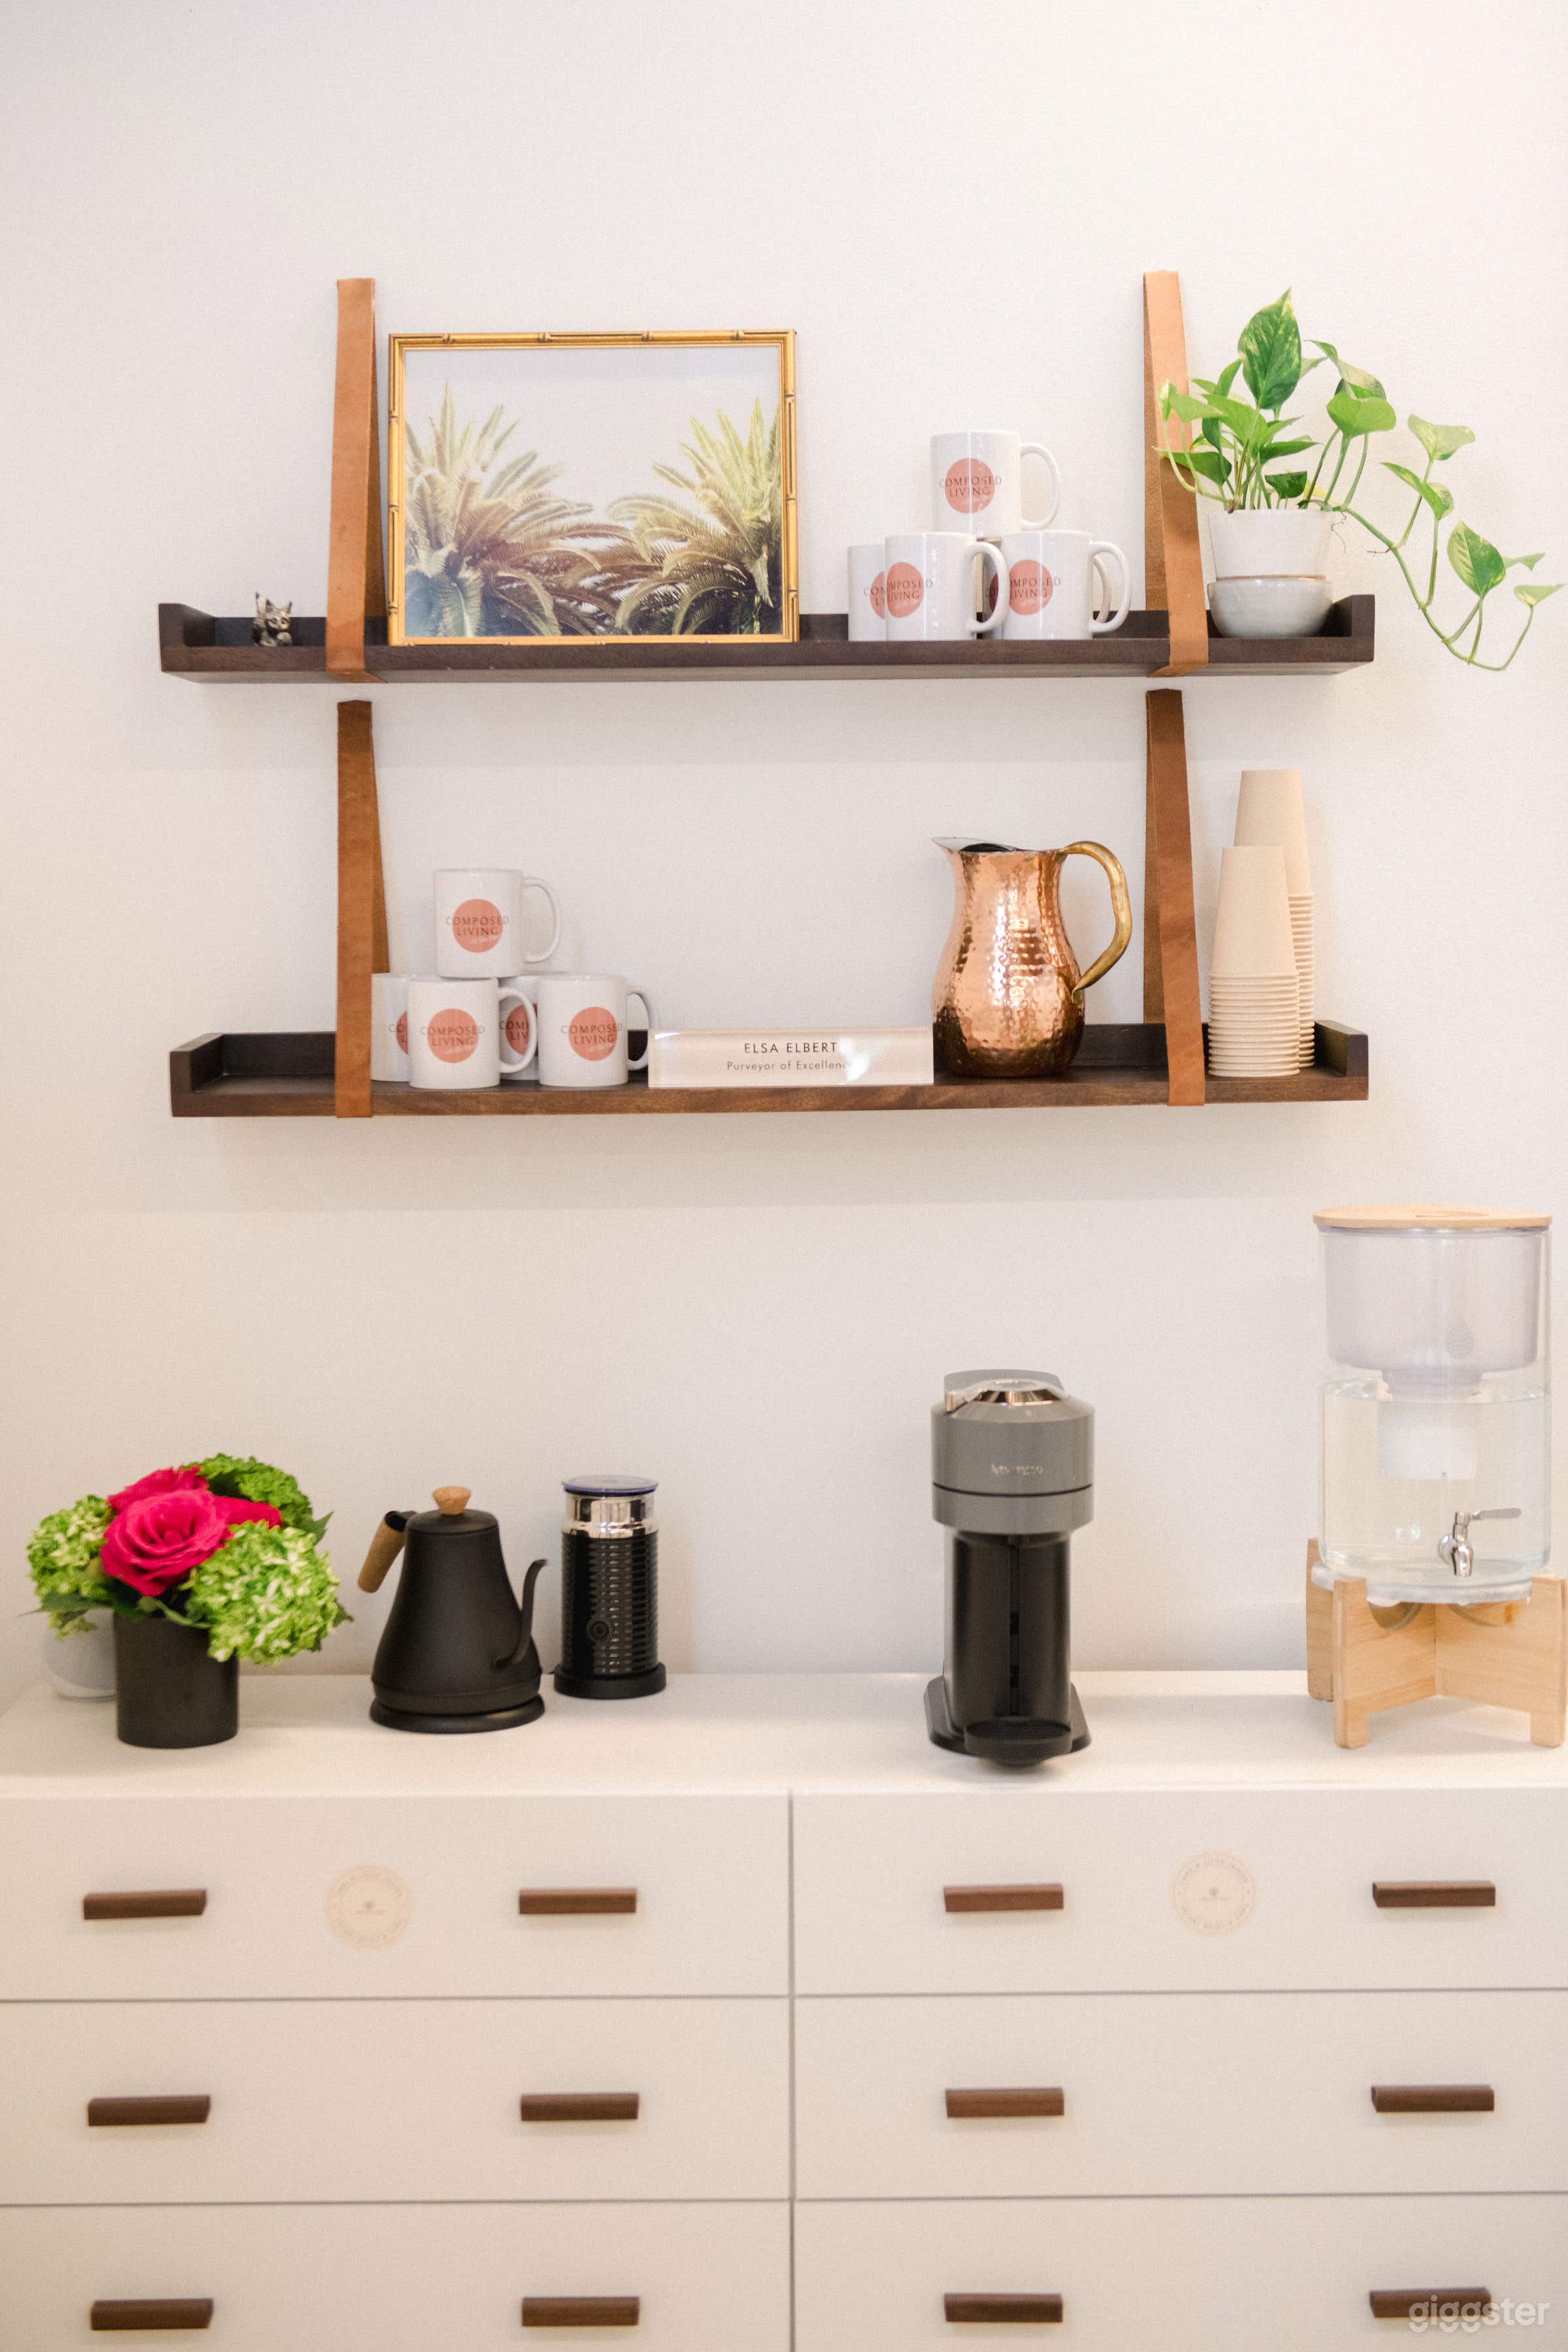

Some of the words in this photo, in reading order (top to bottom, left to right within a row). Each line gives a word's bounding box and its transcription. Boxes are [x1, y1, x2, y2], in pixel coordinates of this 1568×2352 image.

[939, 476, 1002, 488] COMPOSED
[949, 487, 990, 497] LIVING
[887, 580, 933, 592] OMPOSED
[1010, 578, 1061, 587] OMPOSED
[445, 915, 510, 926] COMPOSED
[456, 926, 498, 936] LIVING
[419, 1024, 485, 1036] COMPOSED
[561, 1022, 622, 1034] COMPOSED
[431, 1036, 474, 1046] LIVING
[574, 1034, 614, 1045] LIVING
[743, 1043, 778, 1054] ELSA
[786, 1042, 837, 1053] ELBERT
[727, 1061, 775, 1072] Purveyor
[780, 1060, 791, 1070] of
